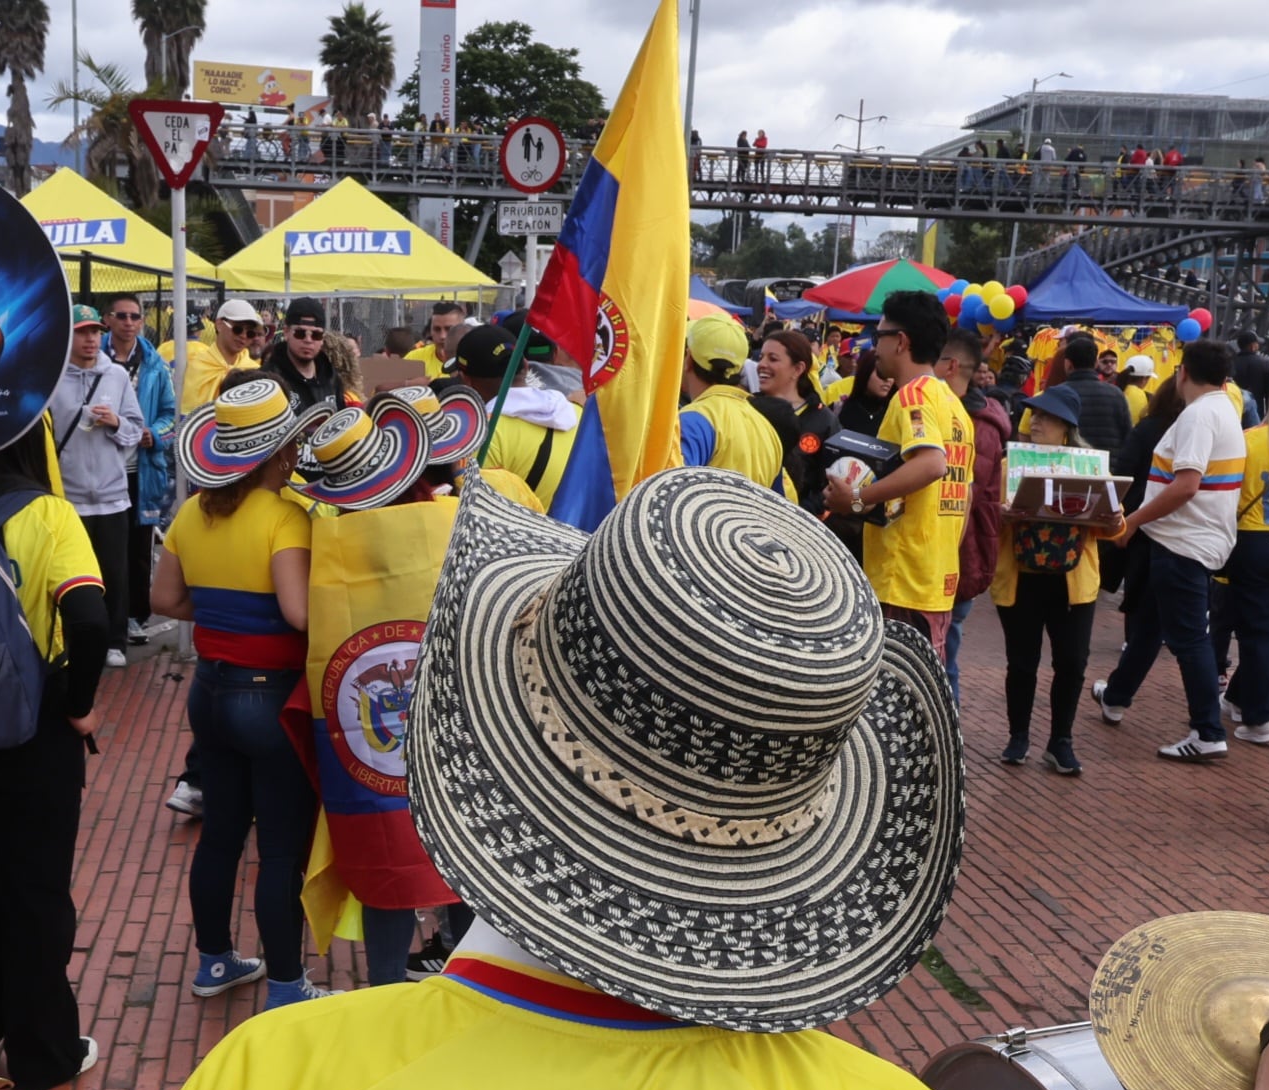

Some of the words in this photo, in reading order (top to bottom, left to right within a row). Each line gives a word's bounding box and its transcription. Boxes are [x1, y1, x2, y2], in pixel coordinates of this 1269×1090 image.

[441, 34, 451, 73] Nariño
[441, 78, 450, 122] ntonio
[165, 115, 190, 128] CEDA
[171, 128, 183, 142] EL
[503, 206, 558, 217] PRIORIDAD
[42, 221, 118, 246] UILA
[438, 211, 450, 247] ampín
[324, 635, 369, 710] REPUBLICA
[384, 624, 406, 638] DE
